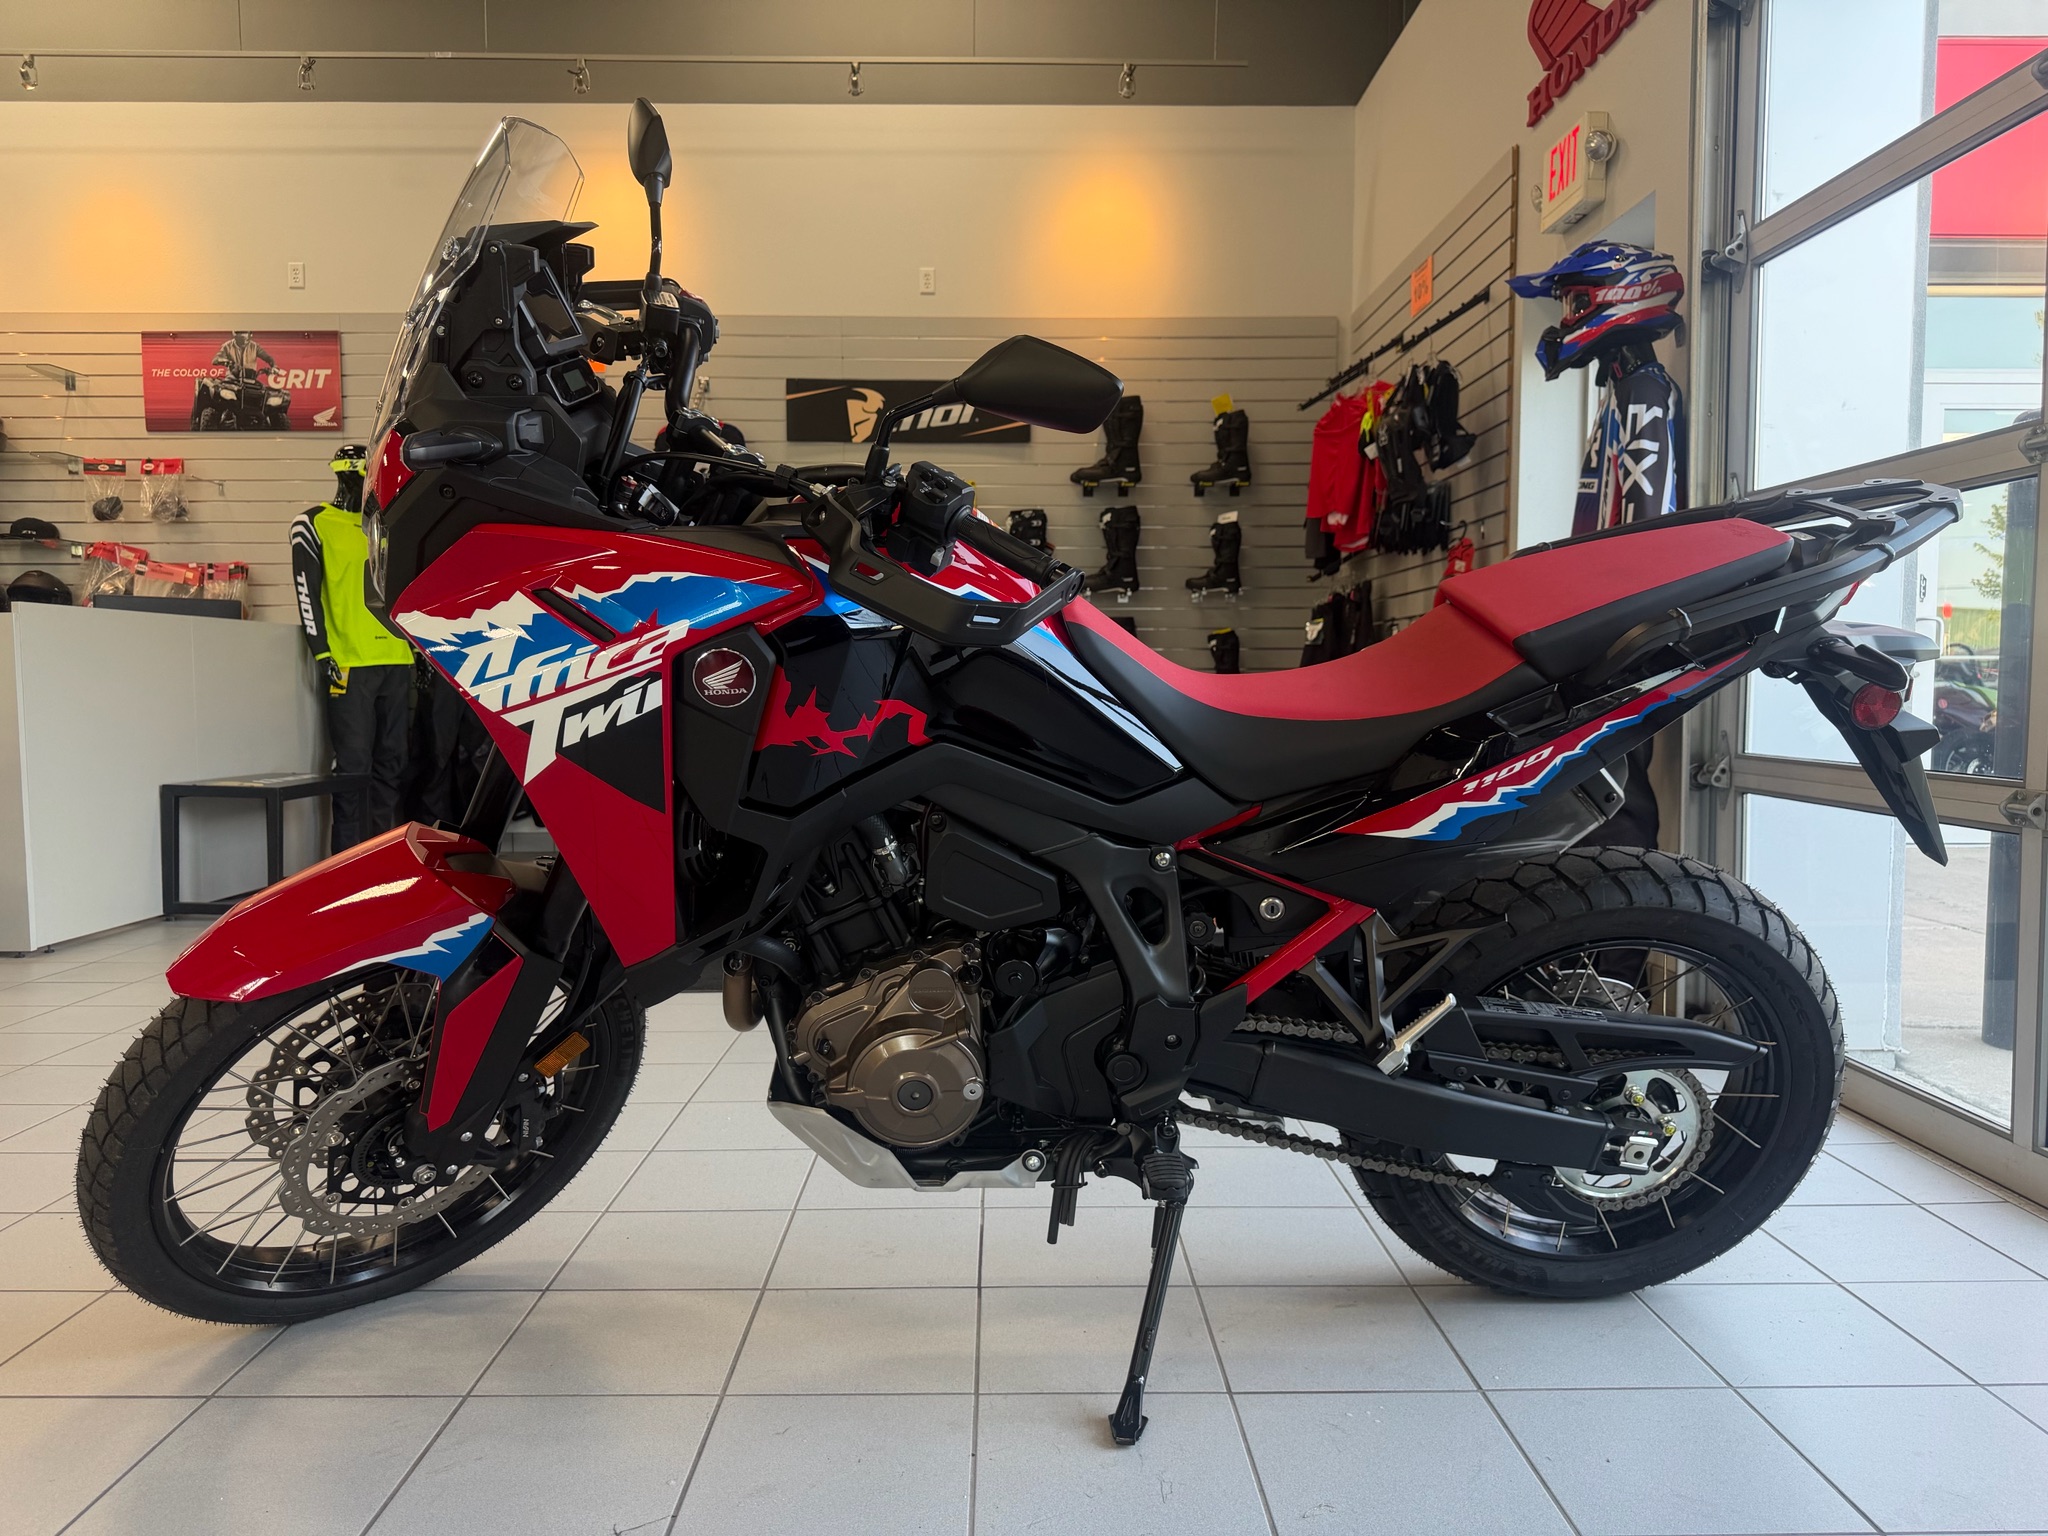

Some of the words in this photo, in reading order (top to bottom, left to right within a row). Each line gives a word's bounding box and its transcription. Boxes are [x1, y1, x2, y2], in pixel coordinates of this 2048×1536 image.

[1549, 124, 1580, 202] EXIT
[1595, 280, 1662, 303] 100%
[151, 368, 171, 377] THE
[173, 368, 207, 377] COLOR
[209, 368, 225, 377] OF
[268, 368, 332, 389] GRIT
[297, 571, 318, 636] THOR
[454, 619, 690, 713] Africa
[703, 687, 748, 696] HONDA
[1462, 745, 1555, 796] 1100
[613, 996, 636, 1075] CHELIN
